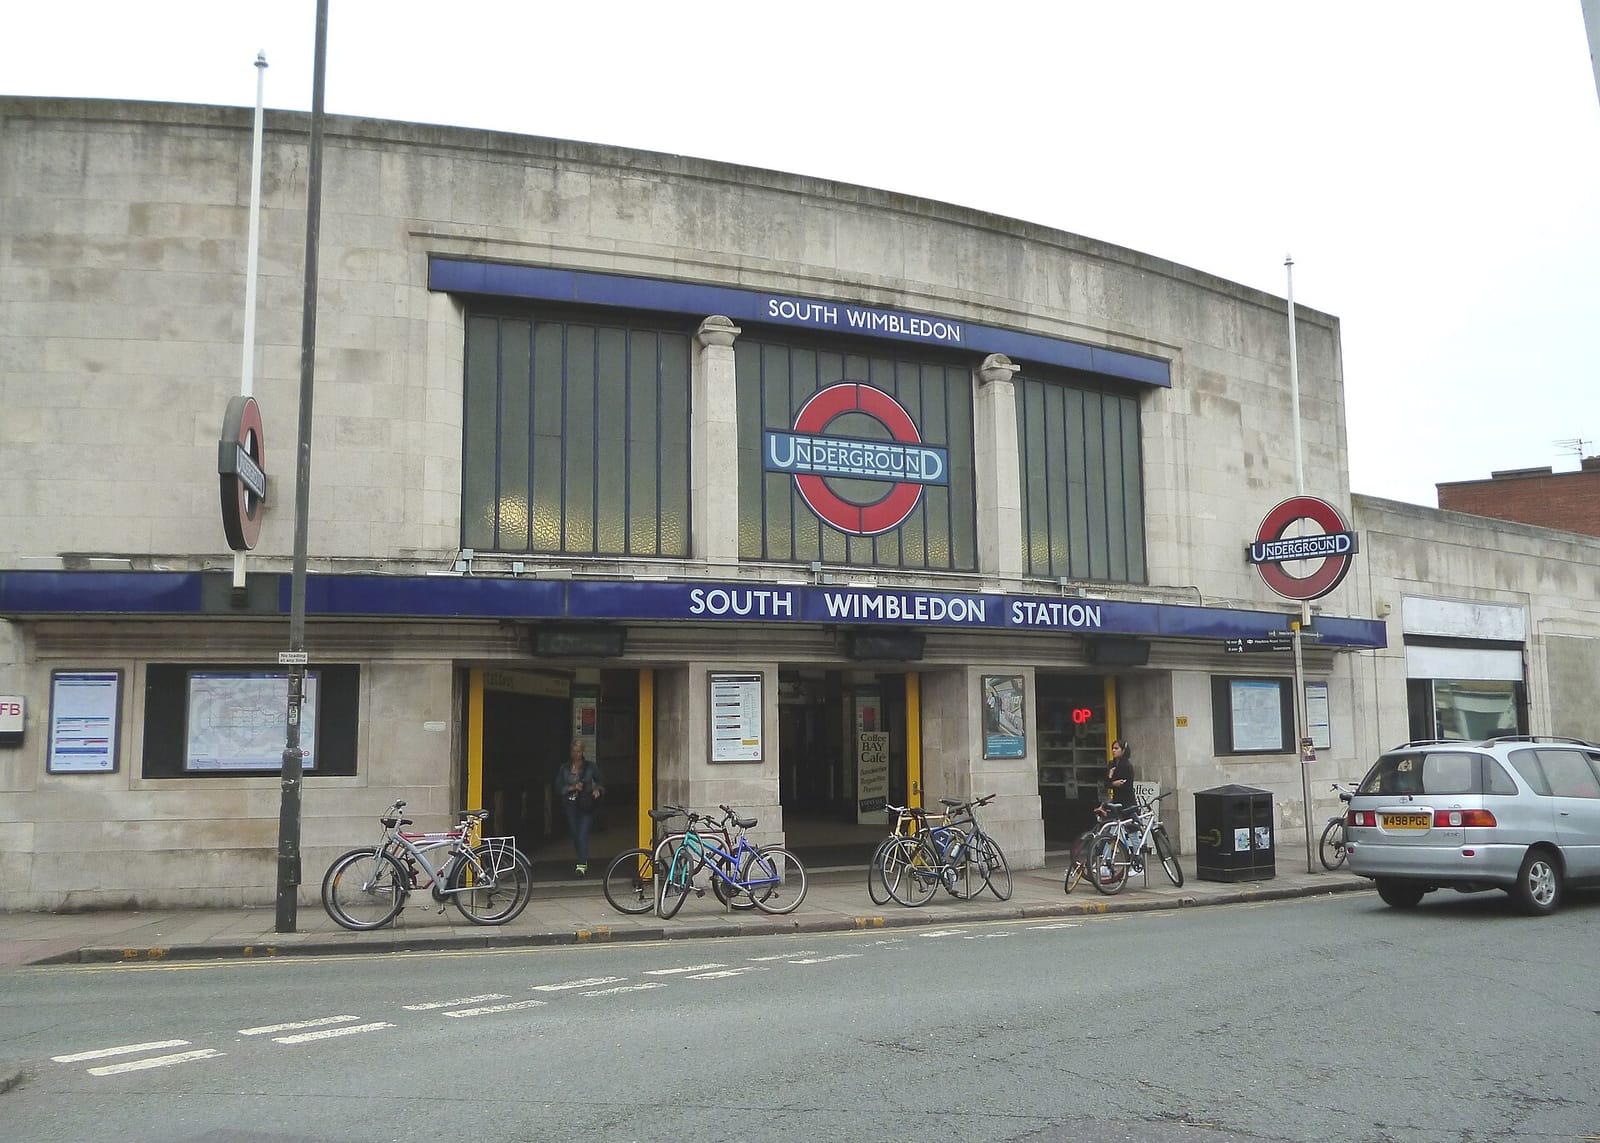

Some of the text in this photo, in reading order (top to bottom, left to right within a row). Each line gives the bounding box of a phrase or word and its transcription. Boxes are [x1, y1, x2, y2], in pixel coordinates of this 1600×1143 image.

[768, 299, 961, 342] SOUTH WIMBLEDON
[770, 434, 943, 480] UNDERGROUND
[1252, 534, 1351, 562] UNDERGROUND
[689, 588, 1101, 627] SOUTH WIMBLEDON STATION
[1072, 707, 1092, 724] OP
[860, 733, 887, 742] Coffee
[862, 742, 884, 752] BAY
[1383, 815, 1428, 826] W498 PGC
